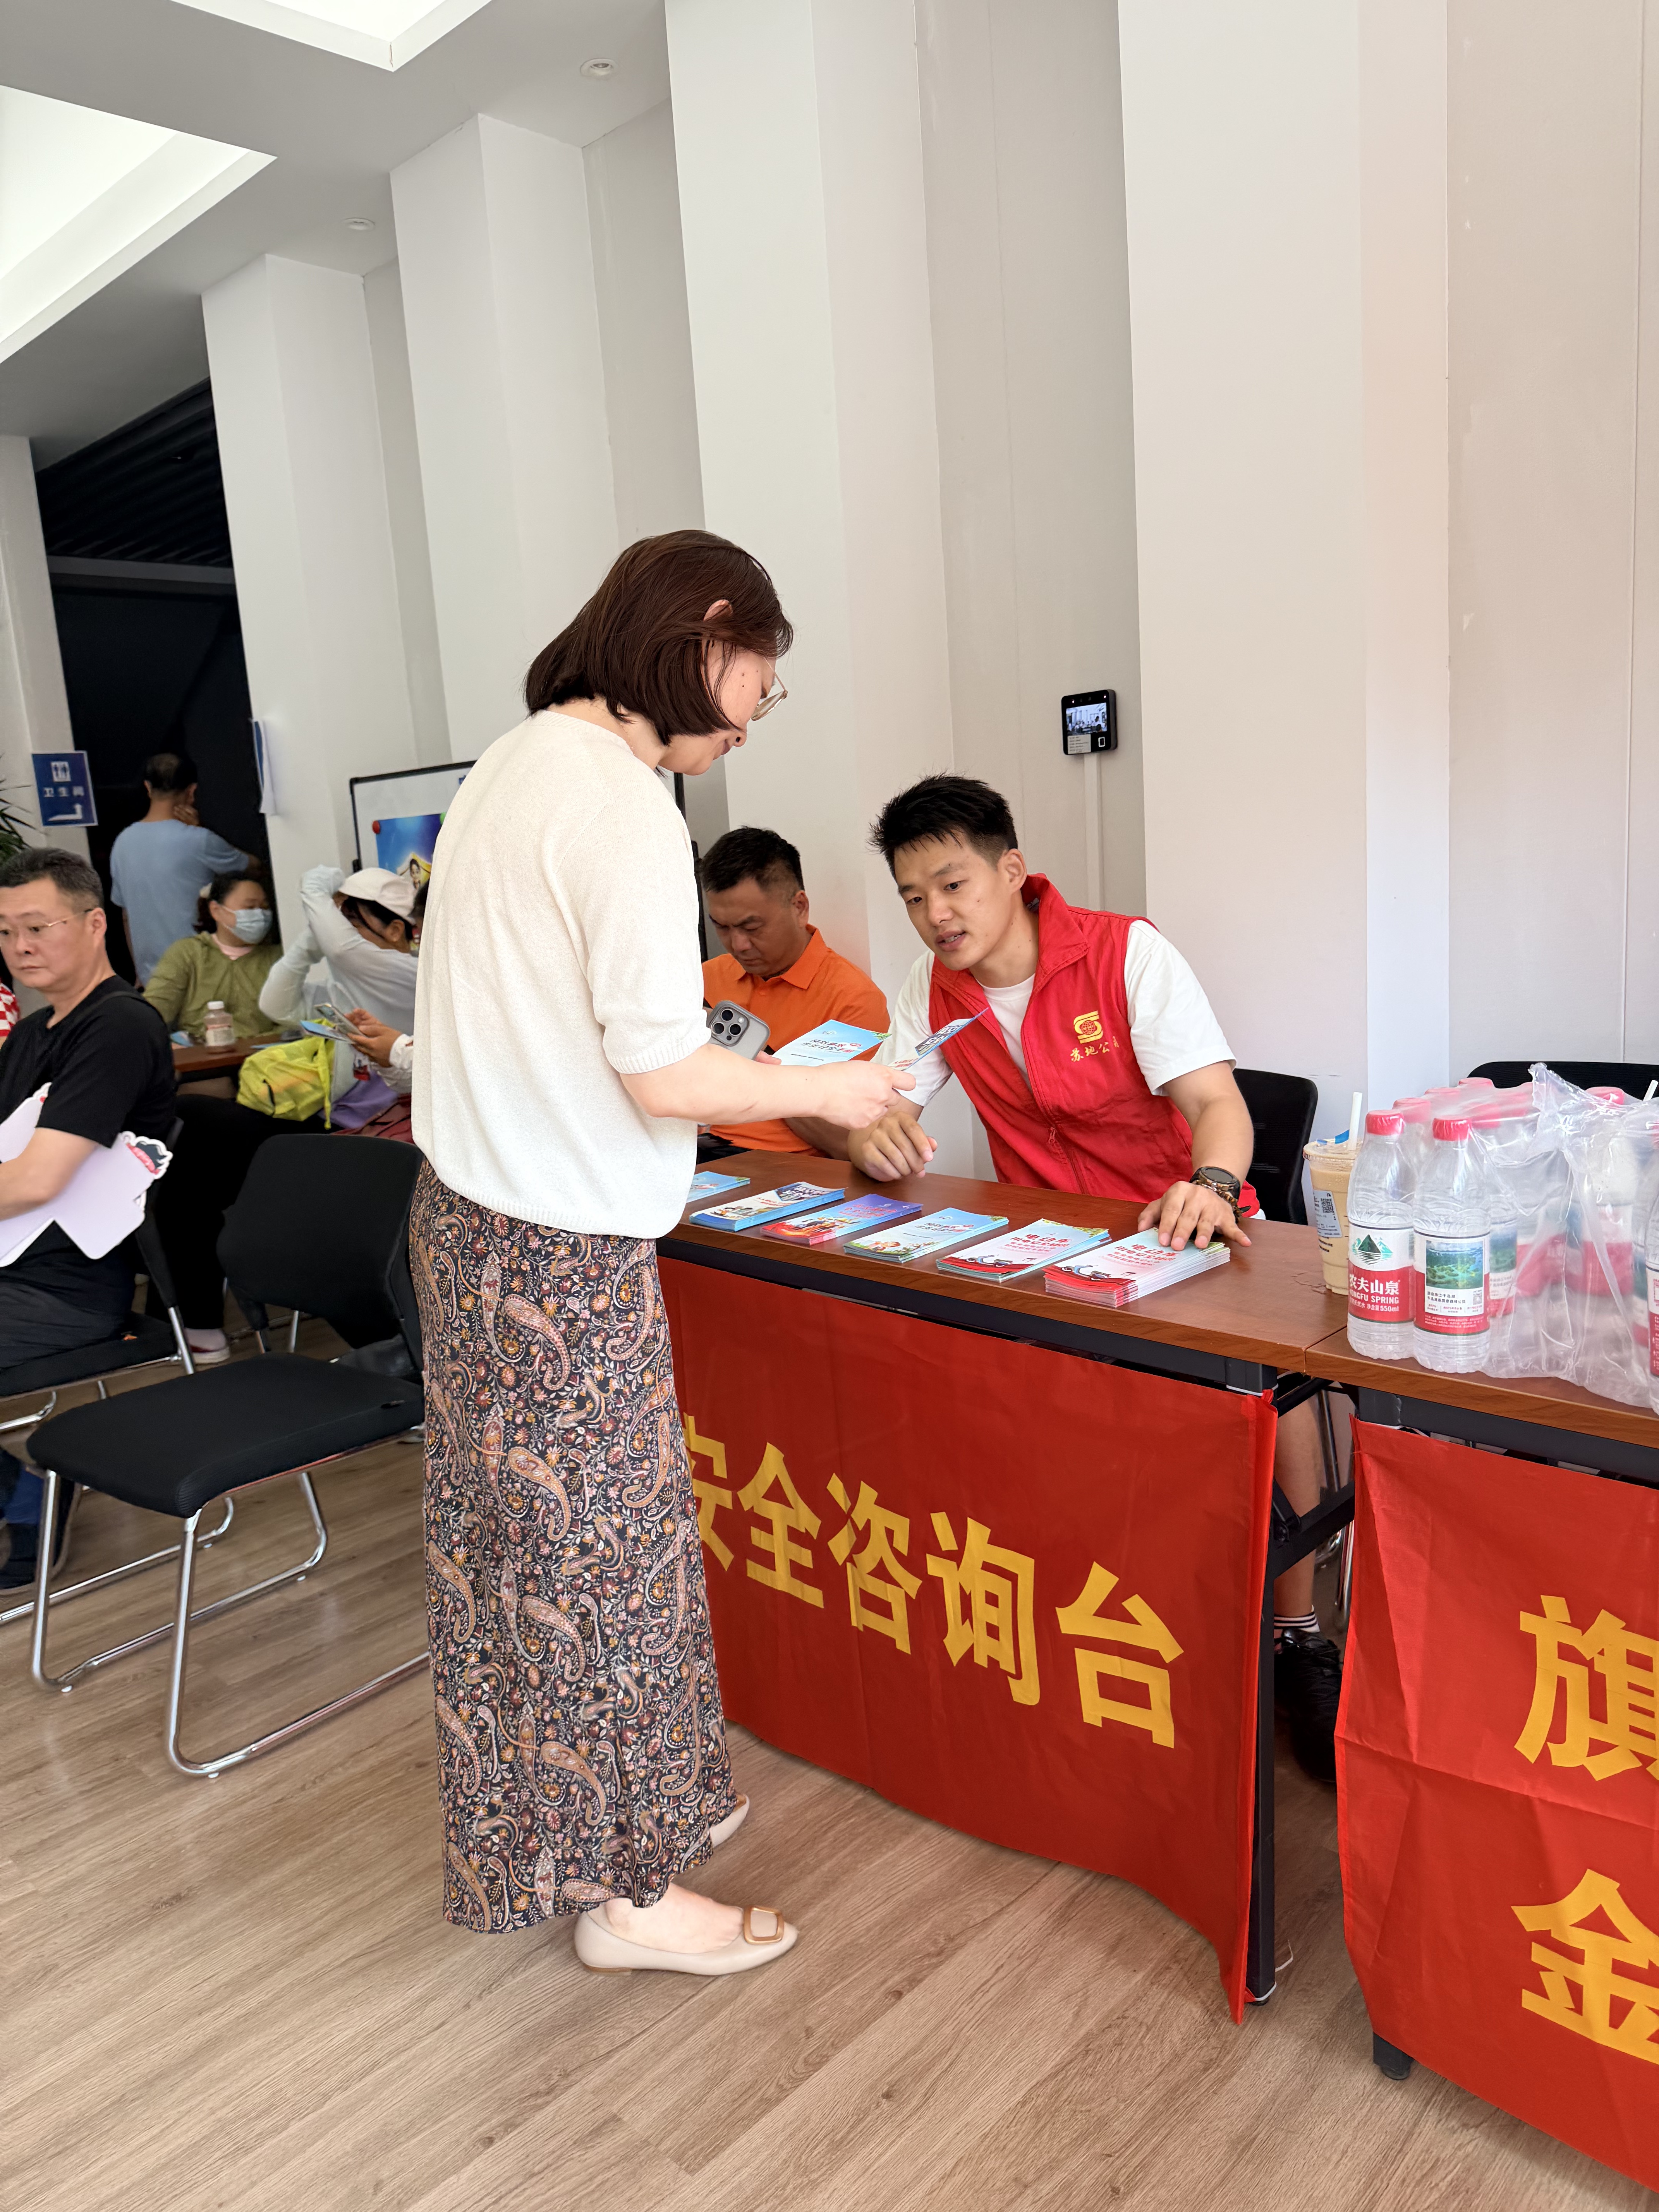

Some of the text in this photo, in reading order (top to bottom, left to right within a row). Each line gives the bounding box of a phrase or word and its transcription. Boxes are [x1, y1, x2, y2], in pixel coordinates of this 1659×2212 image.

[1131, 1244, 1180, 1257] 电动车
[1349, 1274, 1399, 1295] 农夫山泉
[1371, 1295, 1399, 1304] SPRING
[1511, 1869, 1659, 2066] 金
